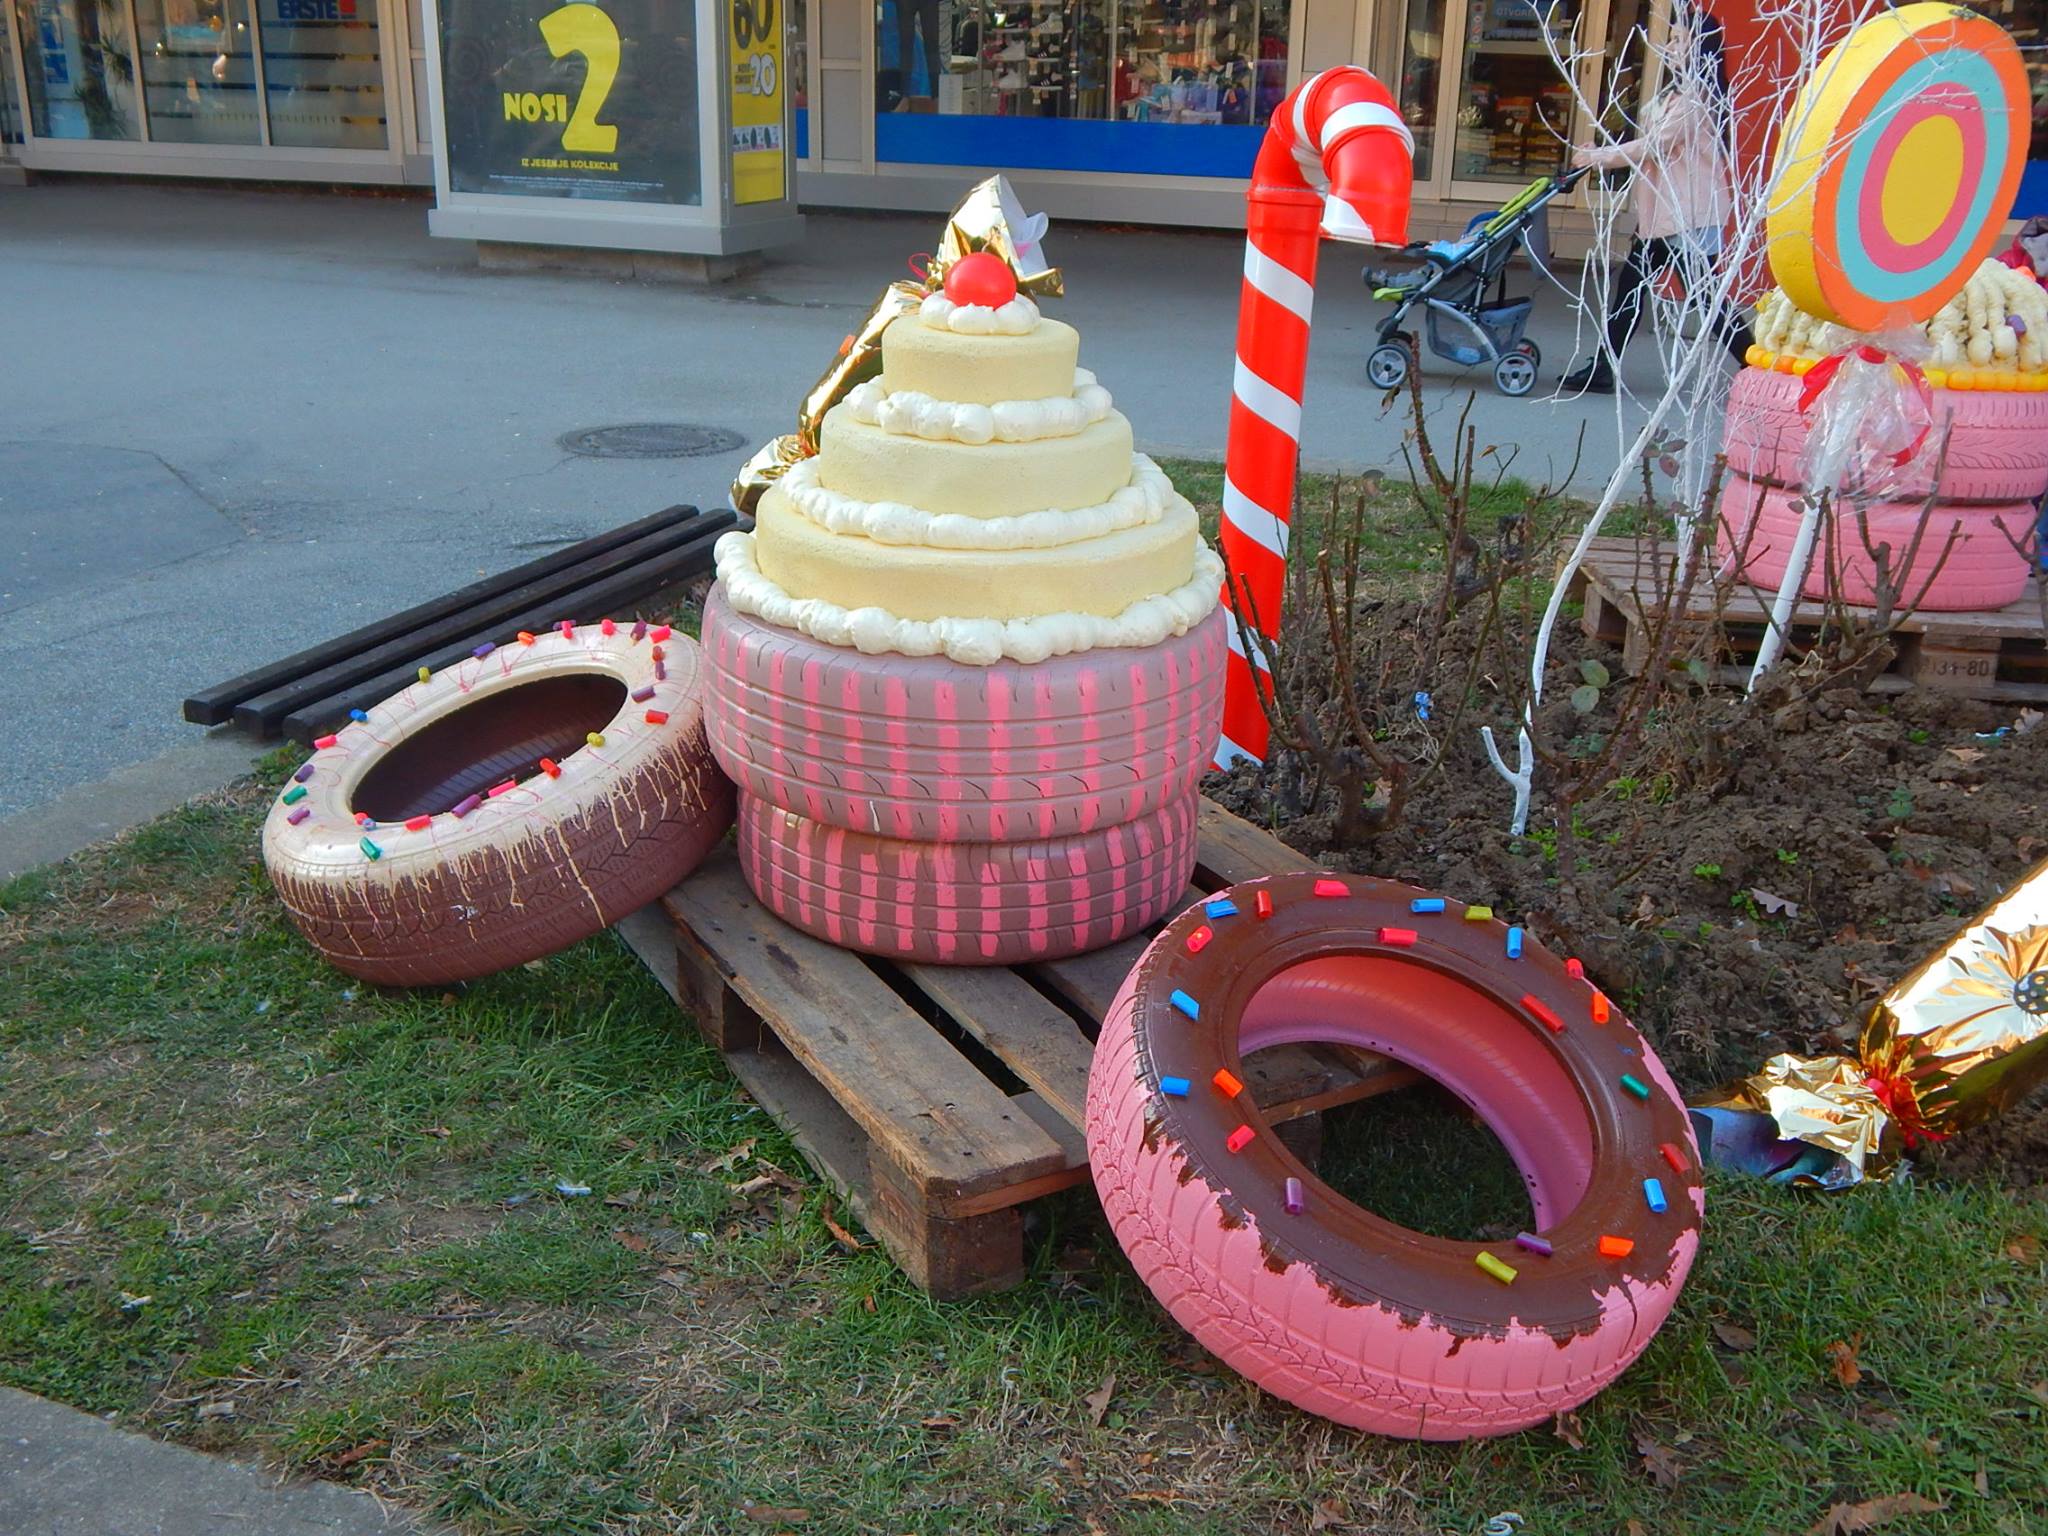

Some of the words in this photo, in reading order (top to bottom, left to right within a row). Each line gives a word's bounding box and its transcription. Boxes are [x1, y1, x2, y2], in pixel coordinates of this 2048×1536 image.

[503, 92, 567, 124] NOSI
[537, 3, 621, 153] 2
[521, 158, 529, 168] IZ
[531, 158, 569, 169] JESENJE
[571, 160, 620, 171] KOLEKCIJE
